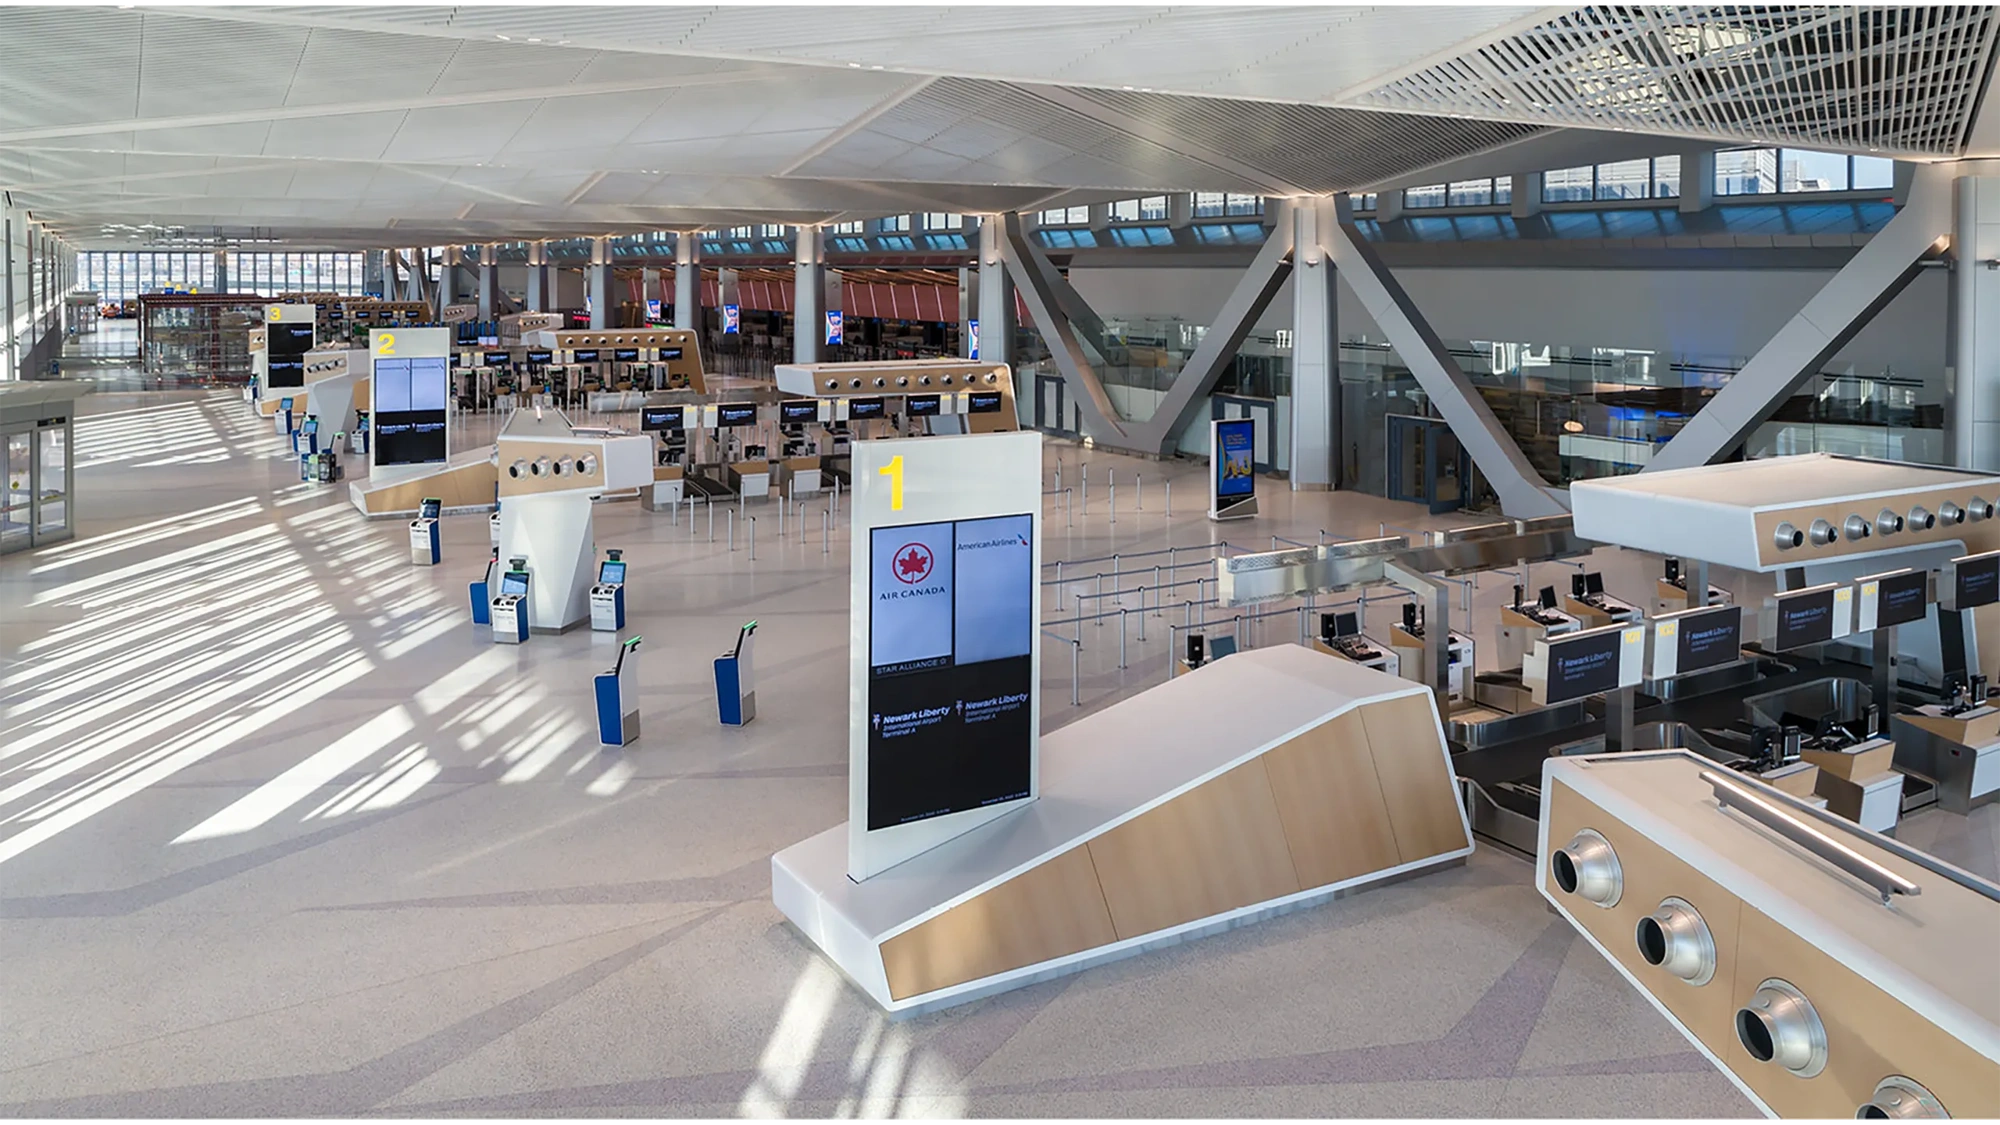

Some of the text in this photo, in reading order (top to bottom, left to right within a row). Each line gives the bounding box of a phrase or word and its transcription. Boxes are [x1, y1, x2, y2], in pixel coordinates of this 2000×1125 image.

[270, 307, 281, 321] 3
[378, 333, 396, 354] 2
[879, 455, 903, 511] 1
[880, 586, 946, 600] AIR CANADA
[876, 660, 938, 675] STAR ALLIANCE
[1564, 651, 1613, 668] Newark Liberty
[965, 693, 1029, 710] Newark Liberty
[883, 706, 950, 724] Newark Liberty
